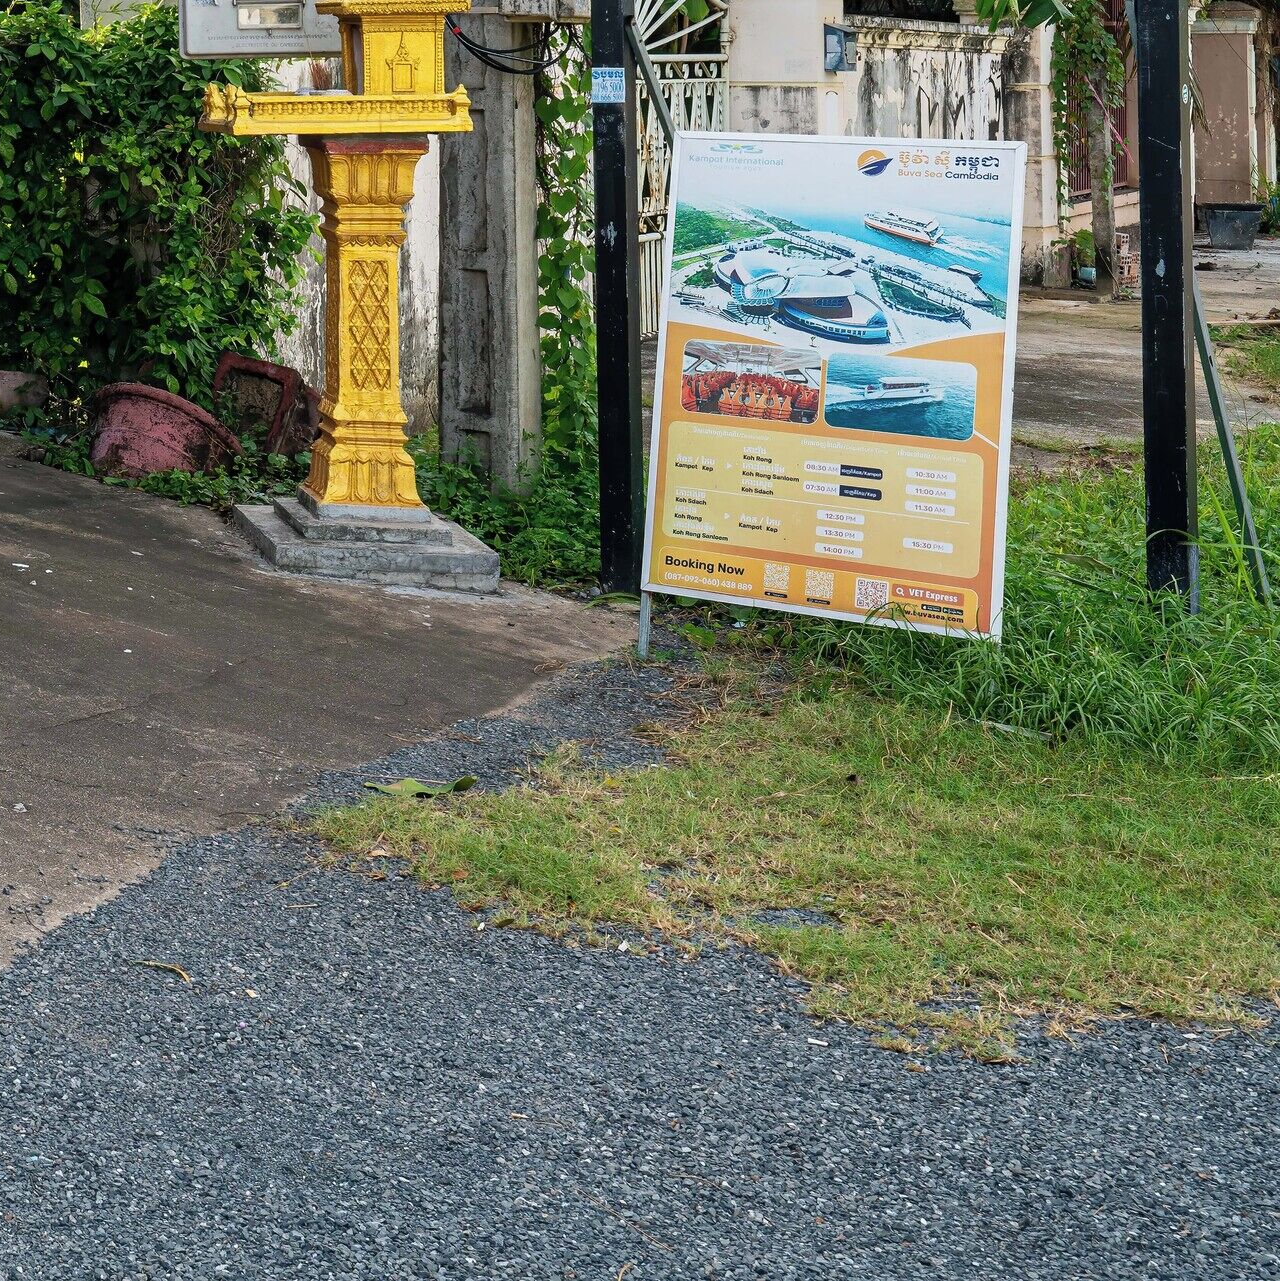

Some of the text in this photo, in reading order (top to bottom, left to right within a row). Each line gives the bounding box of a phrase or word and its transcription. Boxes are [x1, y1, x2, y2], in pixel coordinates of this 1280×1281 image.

[689, 154, 784, 167] Kampot International
[898, 168, 999, 181] Buva Sea Cambodia
[756, 456, 773, 464] Rong
[675, 461, 698, 470] Kampot
[806, 463, 827, 472] 08:30
[755, 472, 772, 480] Rong
[915, 471, 936, 479] 10:30
[754, 488, 774, 496] Sdach
[805, 484, 837, 494] 07:30 AM
[687, 497, 707, 506] Sdach
[674, 512, 686, 520] Koh
[825, 512, 845, 521] 12:30
[672, 528, 684, 536] Koh
[738, 522, 779, 533] Kampot Kep
[824, 529, 856, 539] 13:30 PM
[911, 541, 932, 550] 15:30
[823, 546, 855, 556] 14:00 PM
[665, 555, 745, 576] Booking Now
[909, 588, 958, 603] VET Express
